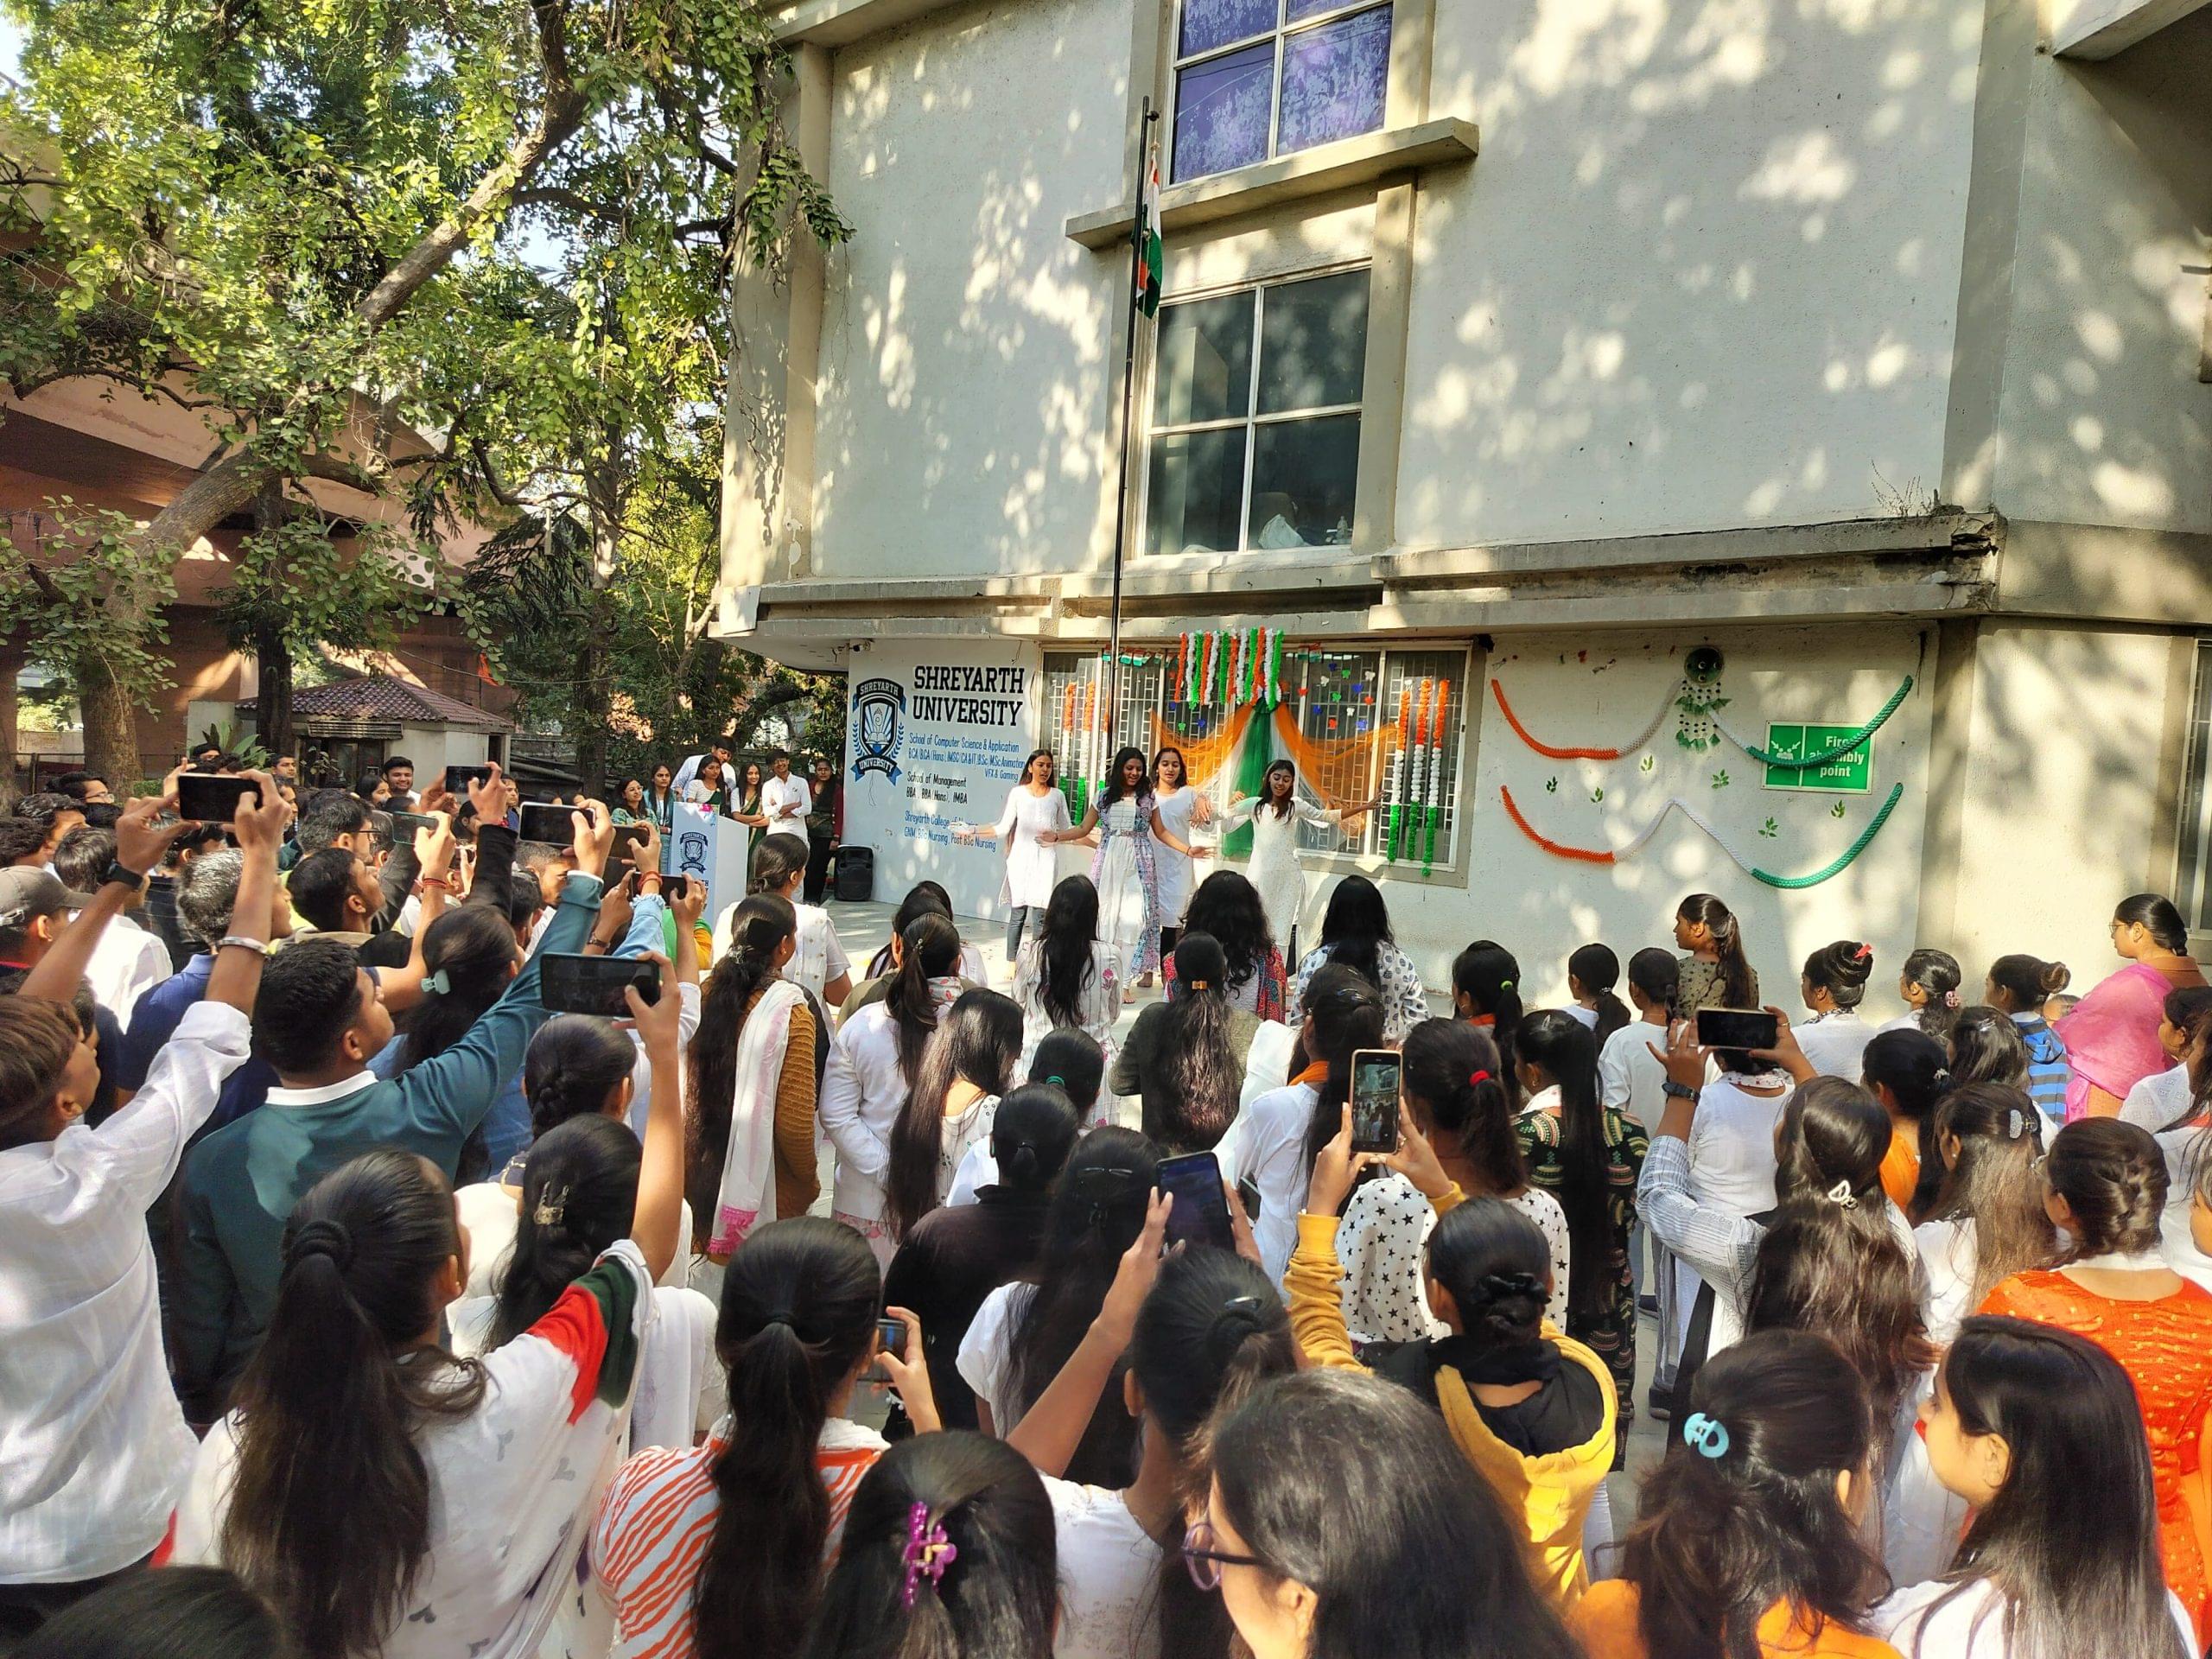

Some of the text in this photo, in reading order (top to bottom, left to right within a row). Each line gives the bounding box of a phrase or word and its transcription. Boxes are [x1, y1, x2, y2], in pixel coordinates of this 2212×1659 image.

[860, 681, 899, 696] SHREYARTH
[913, 665, 1025, 694] SHREYARTH
[912, 695, 1024, 727] UNIVERSITY
[909, 732, 1020, 753] School of Computer Science & Application
[858, 757, 894, 772] UNIVERSITY
[1820, 765, 1852, 779] point
[907, 771, 967, 789] School of Management
[984, 768, 994, 778] VFX
[1000, 770, 1019, 783] Gaming
[952, 791, 968, 804] IMBA
[905, 810, 931, 824] Shreyarth
[931, 814, 950, 829] College
[951, 833, 963, 845] Post
[963, 835, 974, 847] BSc
[975, 836, 996, 853] Nursing
